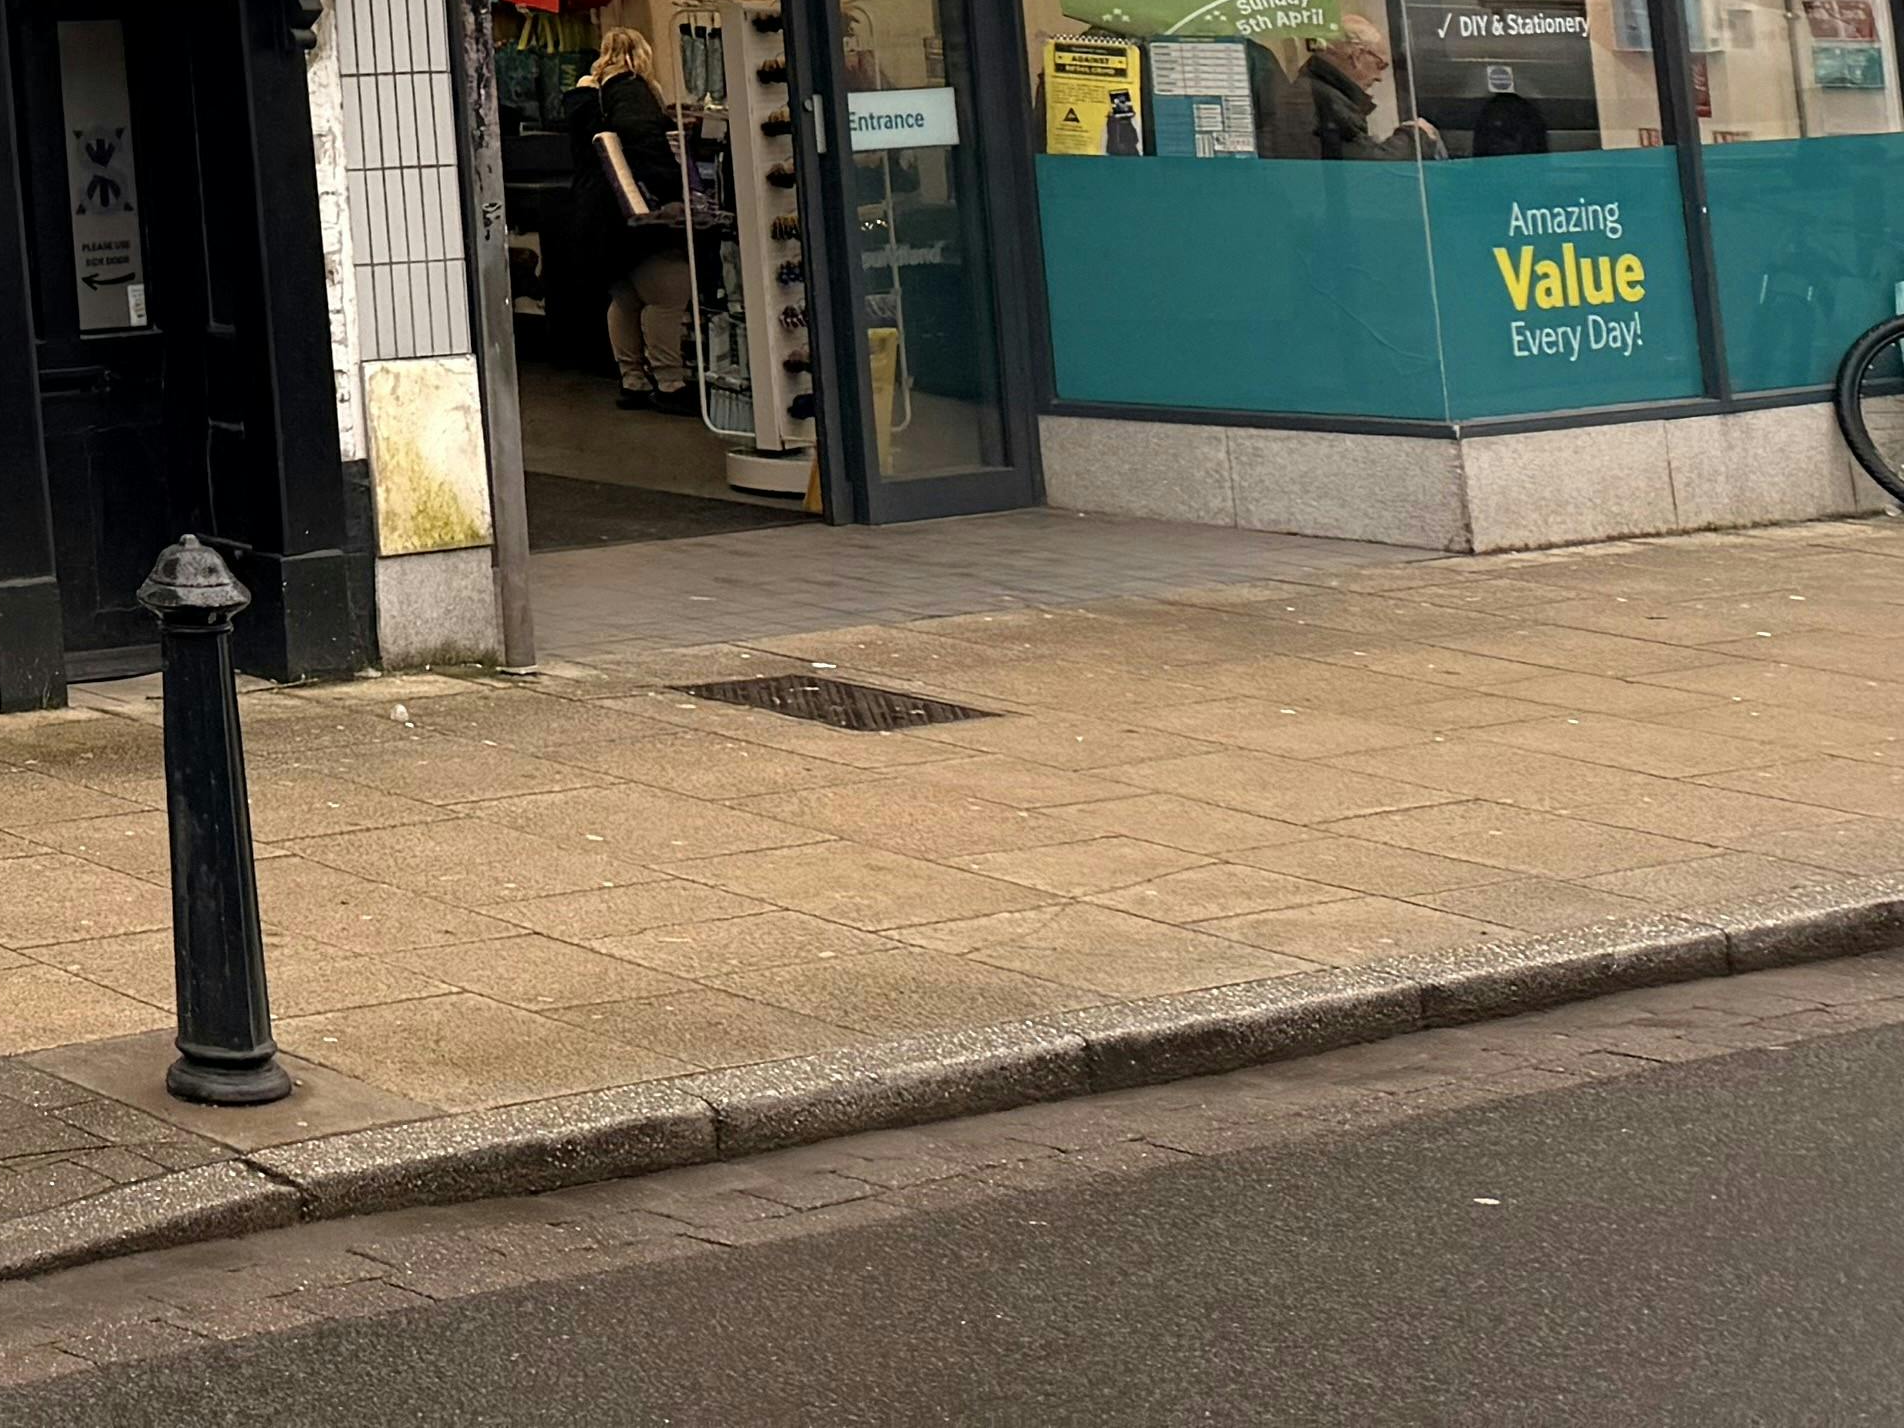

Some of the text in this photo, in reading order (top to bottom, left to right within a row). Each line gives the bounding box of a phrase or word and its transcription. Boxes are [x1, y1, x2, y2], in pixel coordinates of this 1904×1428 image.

[1236, 8, 1324, 35] 5th April
[1459, 13, 1591, 37] DIY & Stationery
[848, 111, 926, 132] Entrance
[1508, 197, 1624, 239] Amazing
[1492, 242, 1646, 312] Value
[1510, 311, 1644, 362] Every Day!
